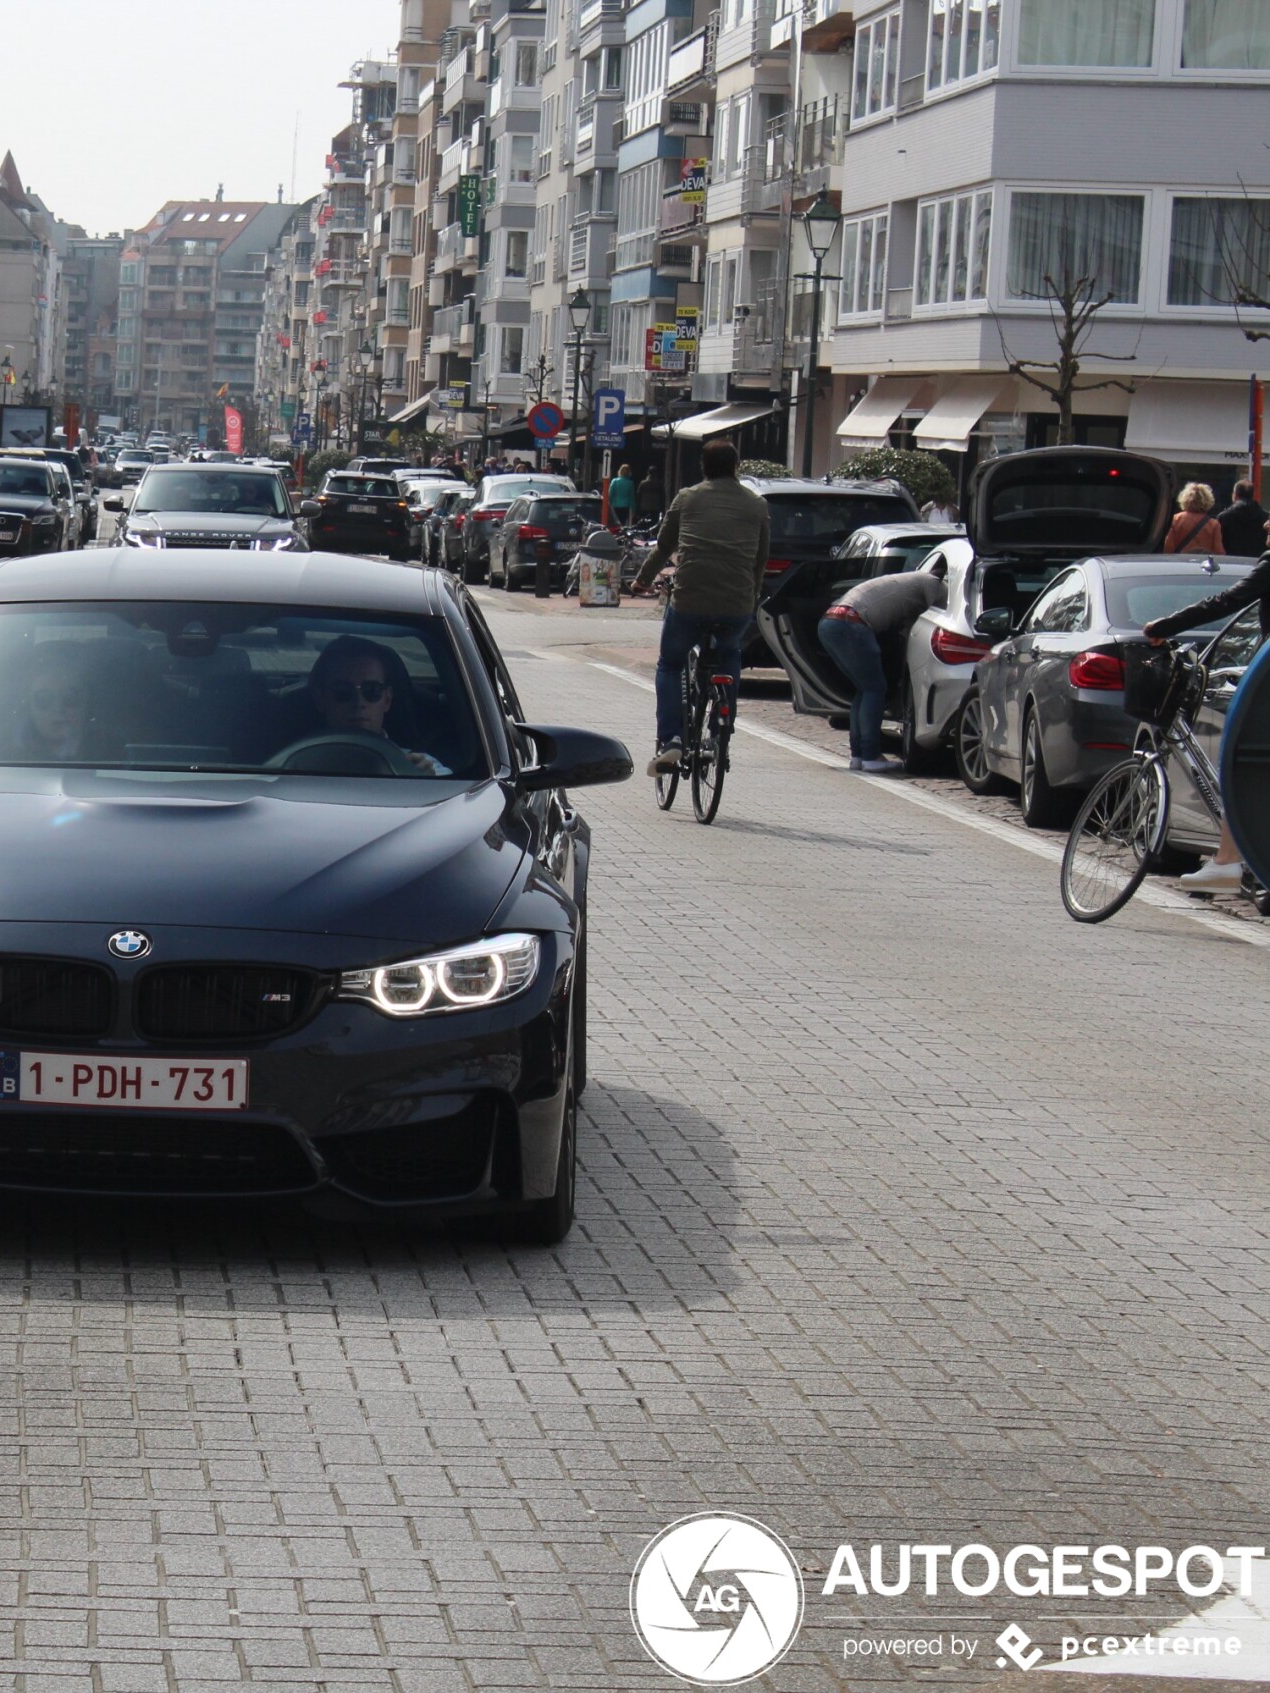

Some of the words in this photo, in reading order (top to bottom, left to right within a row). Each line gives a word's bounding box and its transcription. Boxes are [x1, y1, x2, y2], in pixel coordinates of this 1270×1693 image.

[681, 176, 705, 191] DEVA
[466, 178, 476, 235] HOTEL
[676, 326, 696, 339] DEVA
[598, 396, 620, 426] P
[298, 416, 308, 430] P
[3, 1077, 16, 1093] B
[29, 1061, 235, 1102] 1-PDH-731
